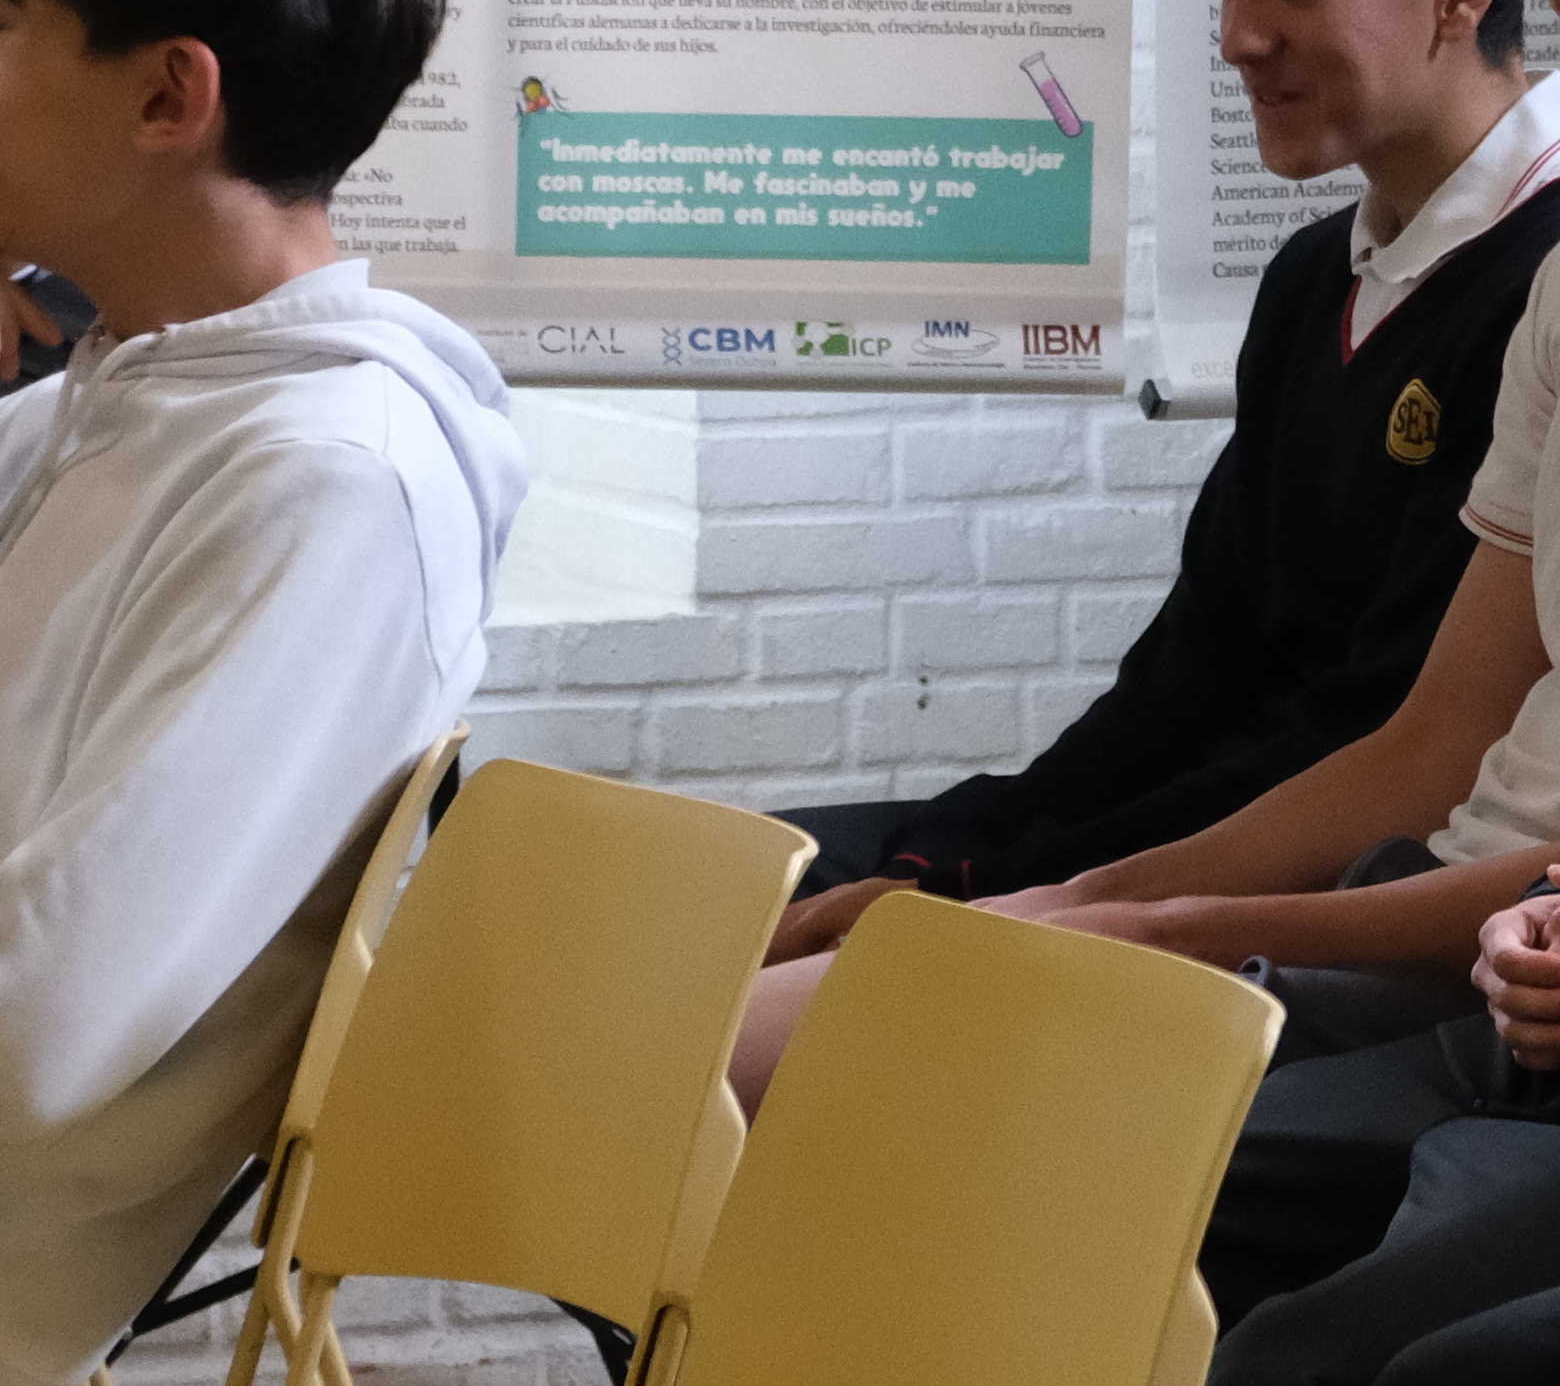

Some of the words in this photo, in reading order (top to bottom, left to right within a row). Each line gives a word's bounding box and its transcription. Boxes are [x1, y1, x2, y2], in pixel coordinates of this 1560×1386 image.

[782, 147, 822, 165] me
[832, 144, 939, 167] encantó
[948, 145, 1065, 176] trabajar
[538, 174, 584, 192] con
[592, 174, 693, 193] moscas.
[704, 170, 744, 194] Me
[753, 171, 900, 196] fascinaban
[909, 180, 927, 204] y
[936, 180, 976, 198] me
[538, 199, 725, 230] acompañaban
[734, 207, 767, 225] en
[775, 201, 818, 225] mis
